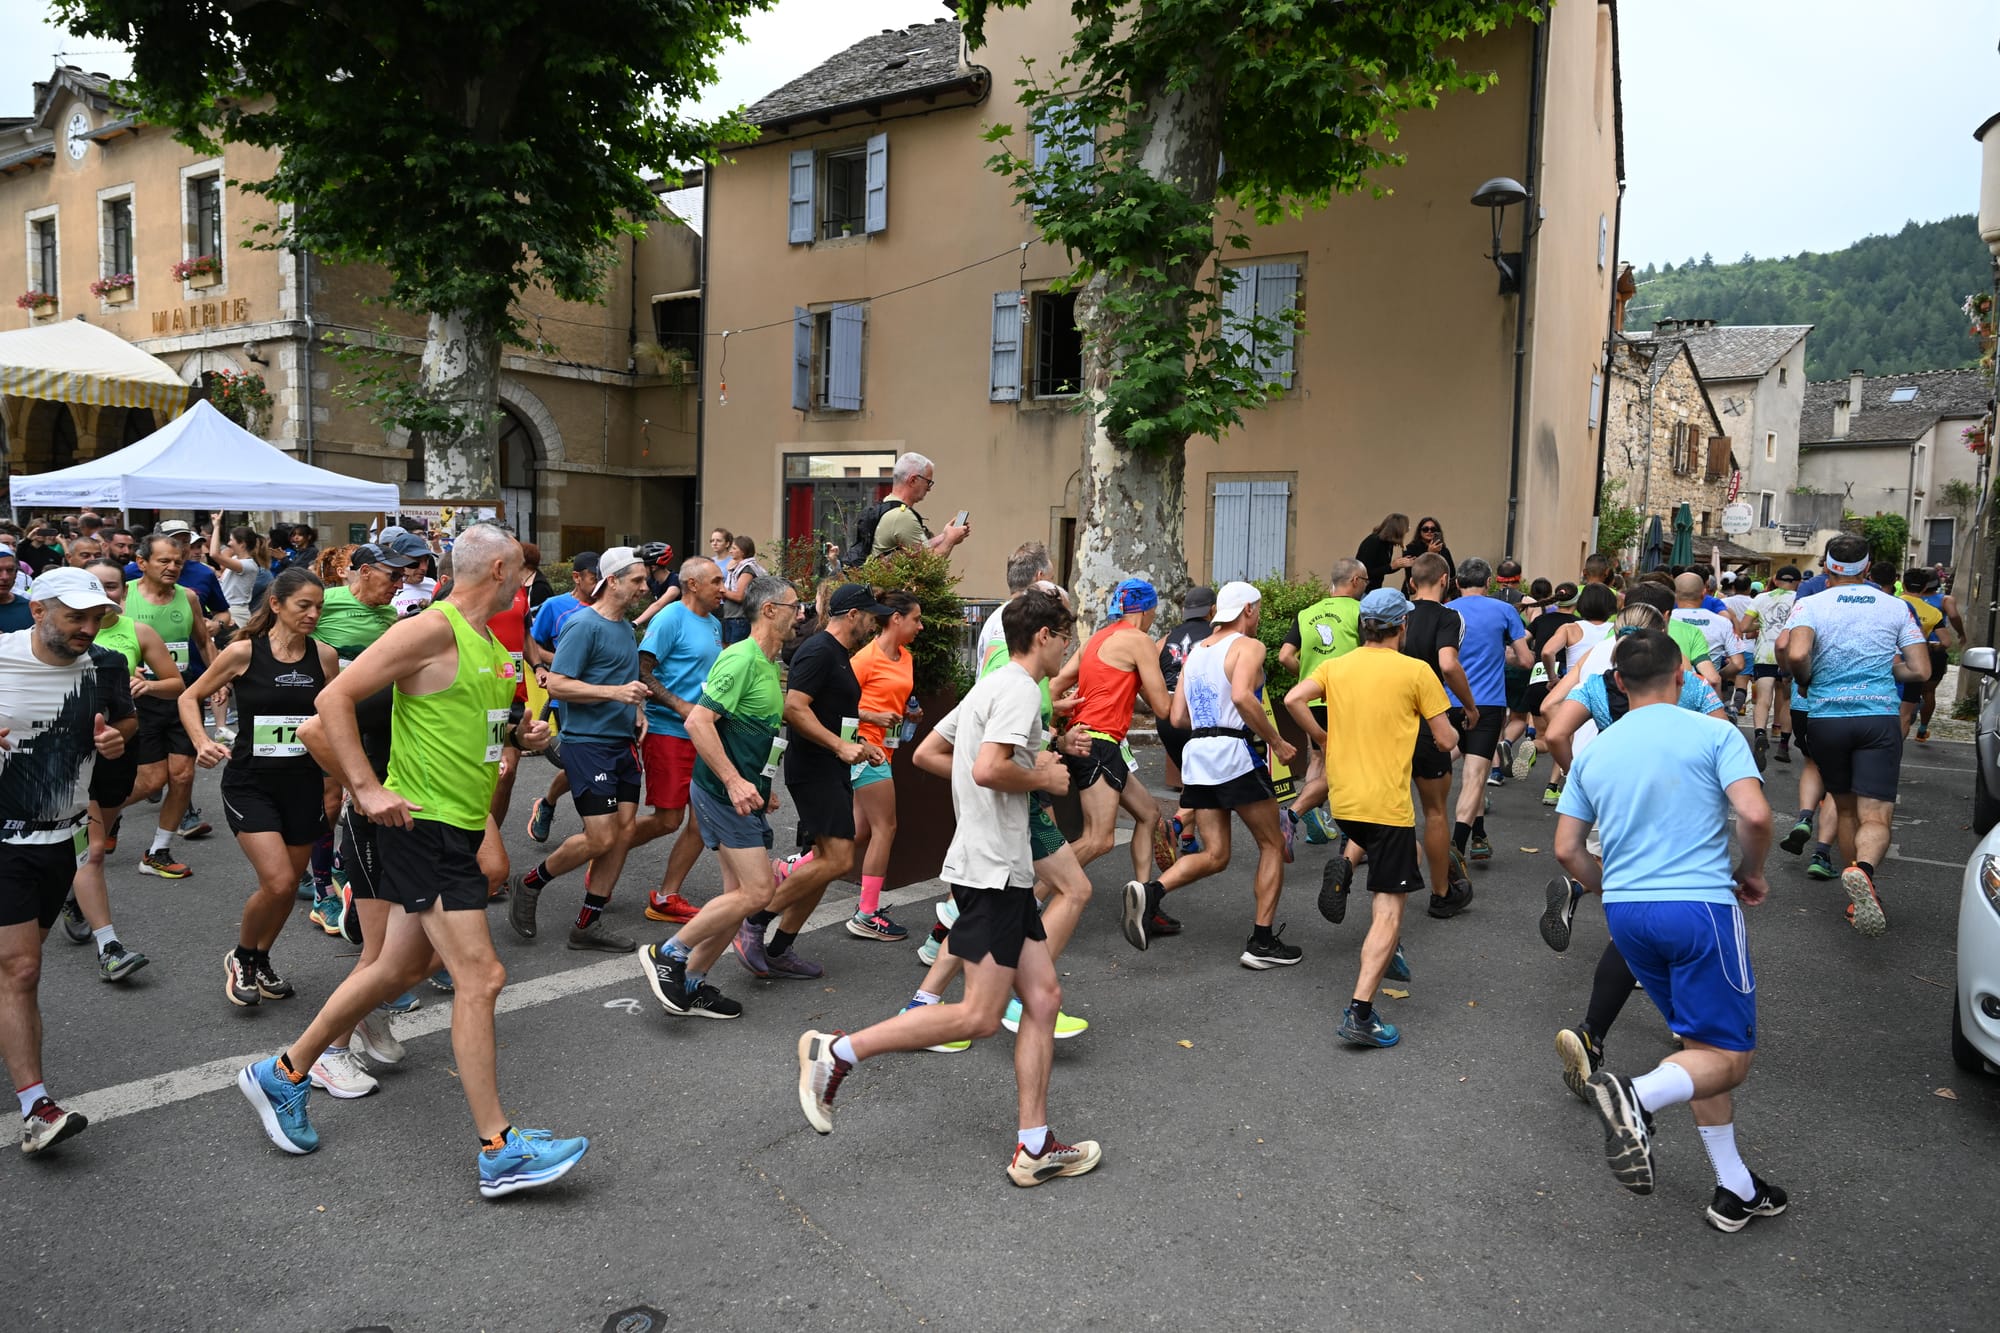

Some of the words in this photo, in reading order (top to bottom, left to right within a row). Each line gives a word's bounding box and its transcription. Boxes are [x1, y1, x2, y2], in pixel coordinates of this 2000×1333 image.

[152, 298, 247, 333] MAIRIE
[1728, 470, 1739, 500] TABAC
[1836, 594, 1876, 604] MARCO
[272, 727, 298, 743] 17
